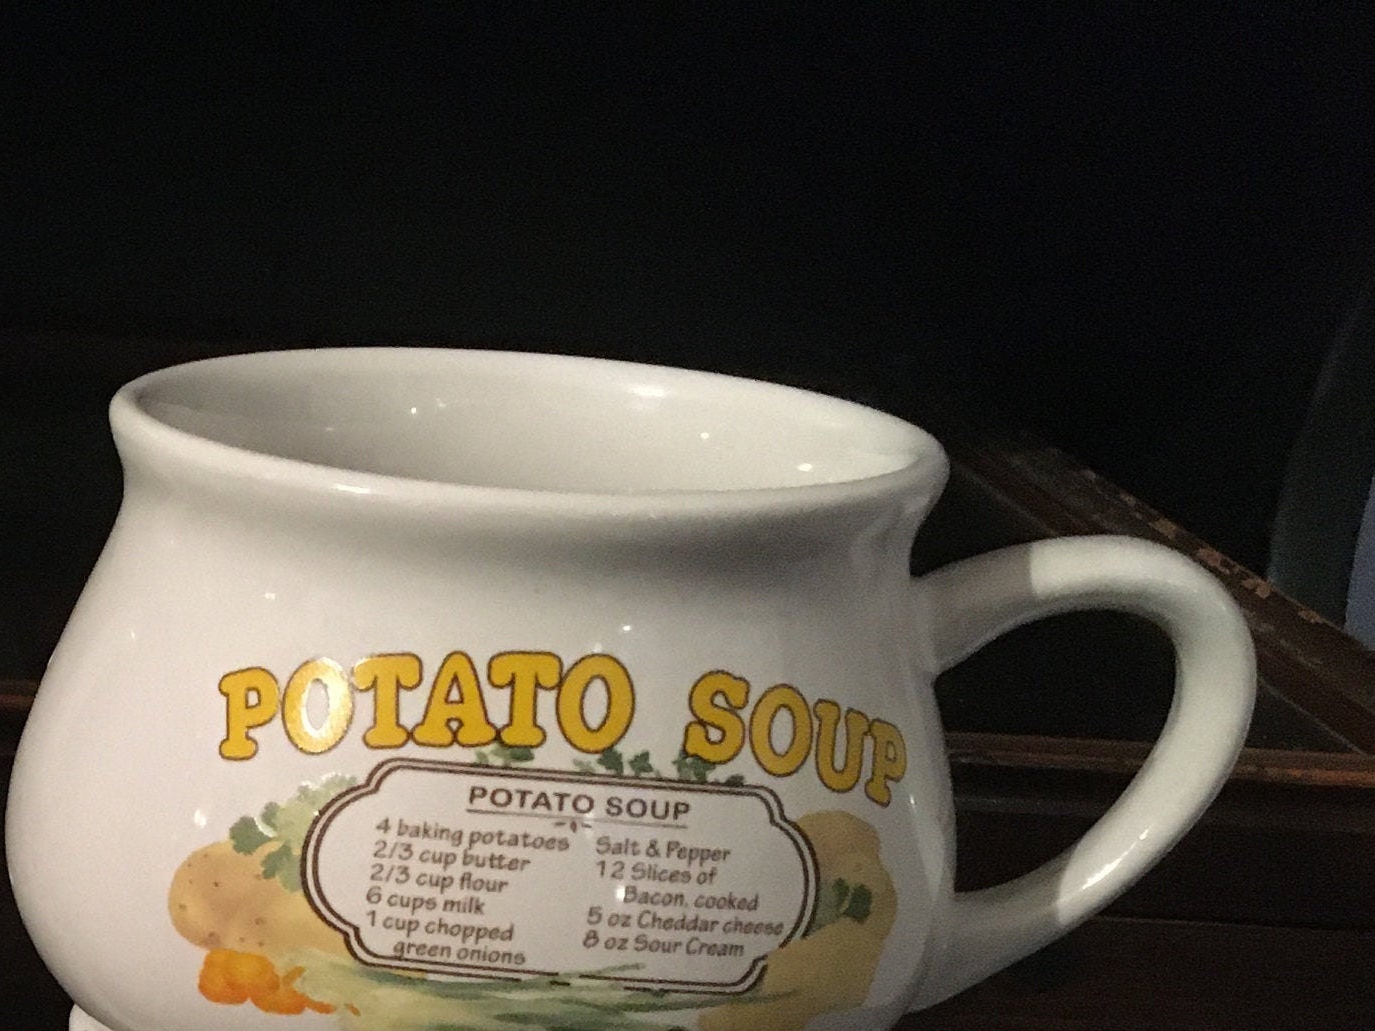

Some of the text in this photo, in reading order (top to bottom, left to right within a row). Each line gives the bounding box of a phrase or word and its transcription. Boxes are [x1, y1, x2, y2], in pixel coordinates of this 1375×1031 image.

[218, 650, 908, 806] POTATO SOUP
[469, 785, 691, 822] POTATO SOUP
[375, 819, 570, 853] 4 baking potatoes
[595, 836, 731, 865] Salt & Pepper
[373, 840, 531, 872] 2/3 cup butter
[370, 863, 508, 895] 2/3 cup flour
[597, 861, 717, 885] 12 Slices of
[365, 886, 485, 916] 6 cups milk
[693, 894, 759, 912] cooked
[366, 911, 514, 943] 1 cup chopped
[587, 907, 784, 937] 5 oz Cheddar cheese
[392, 940, 525, 966] green onions
[583, 930, 744, 958] 8 oz Sour Cream
